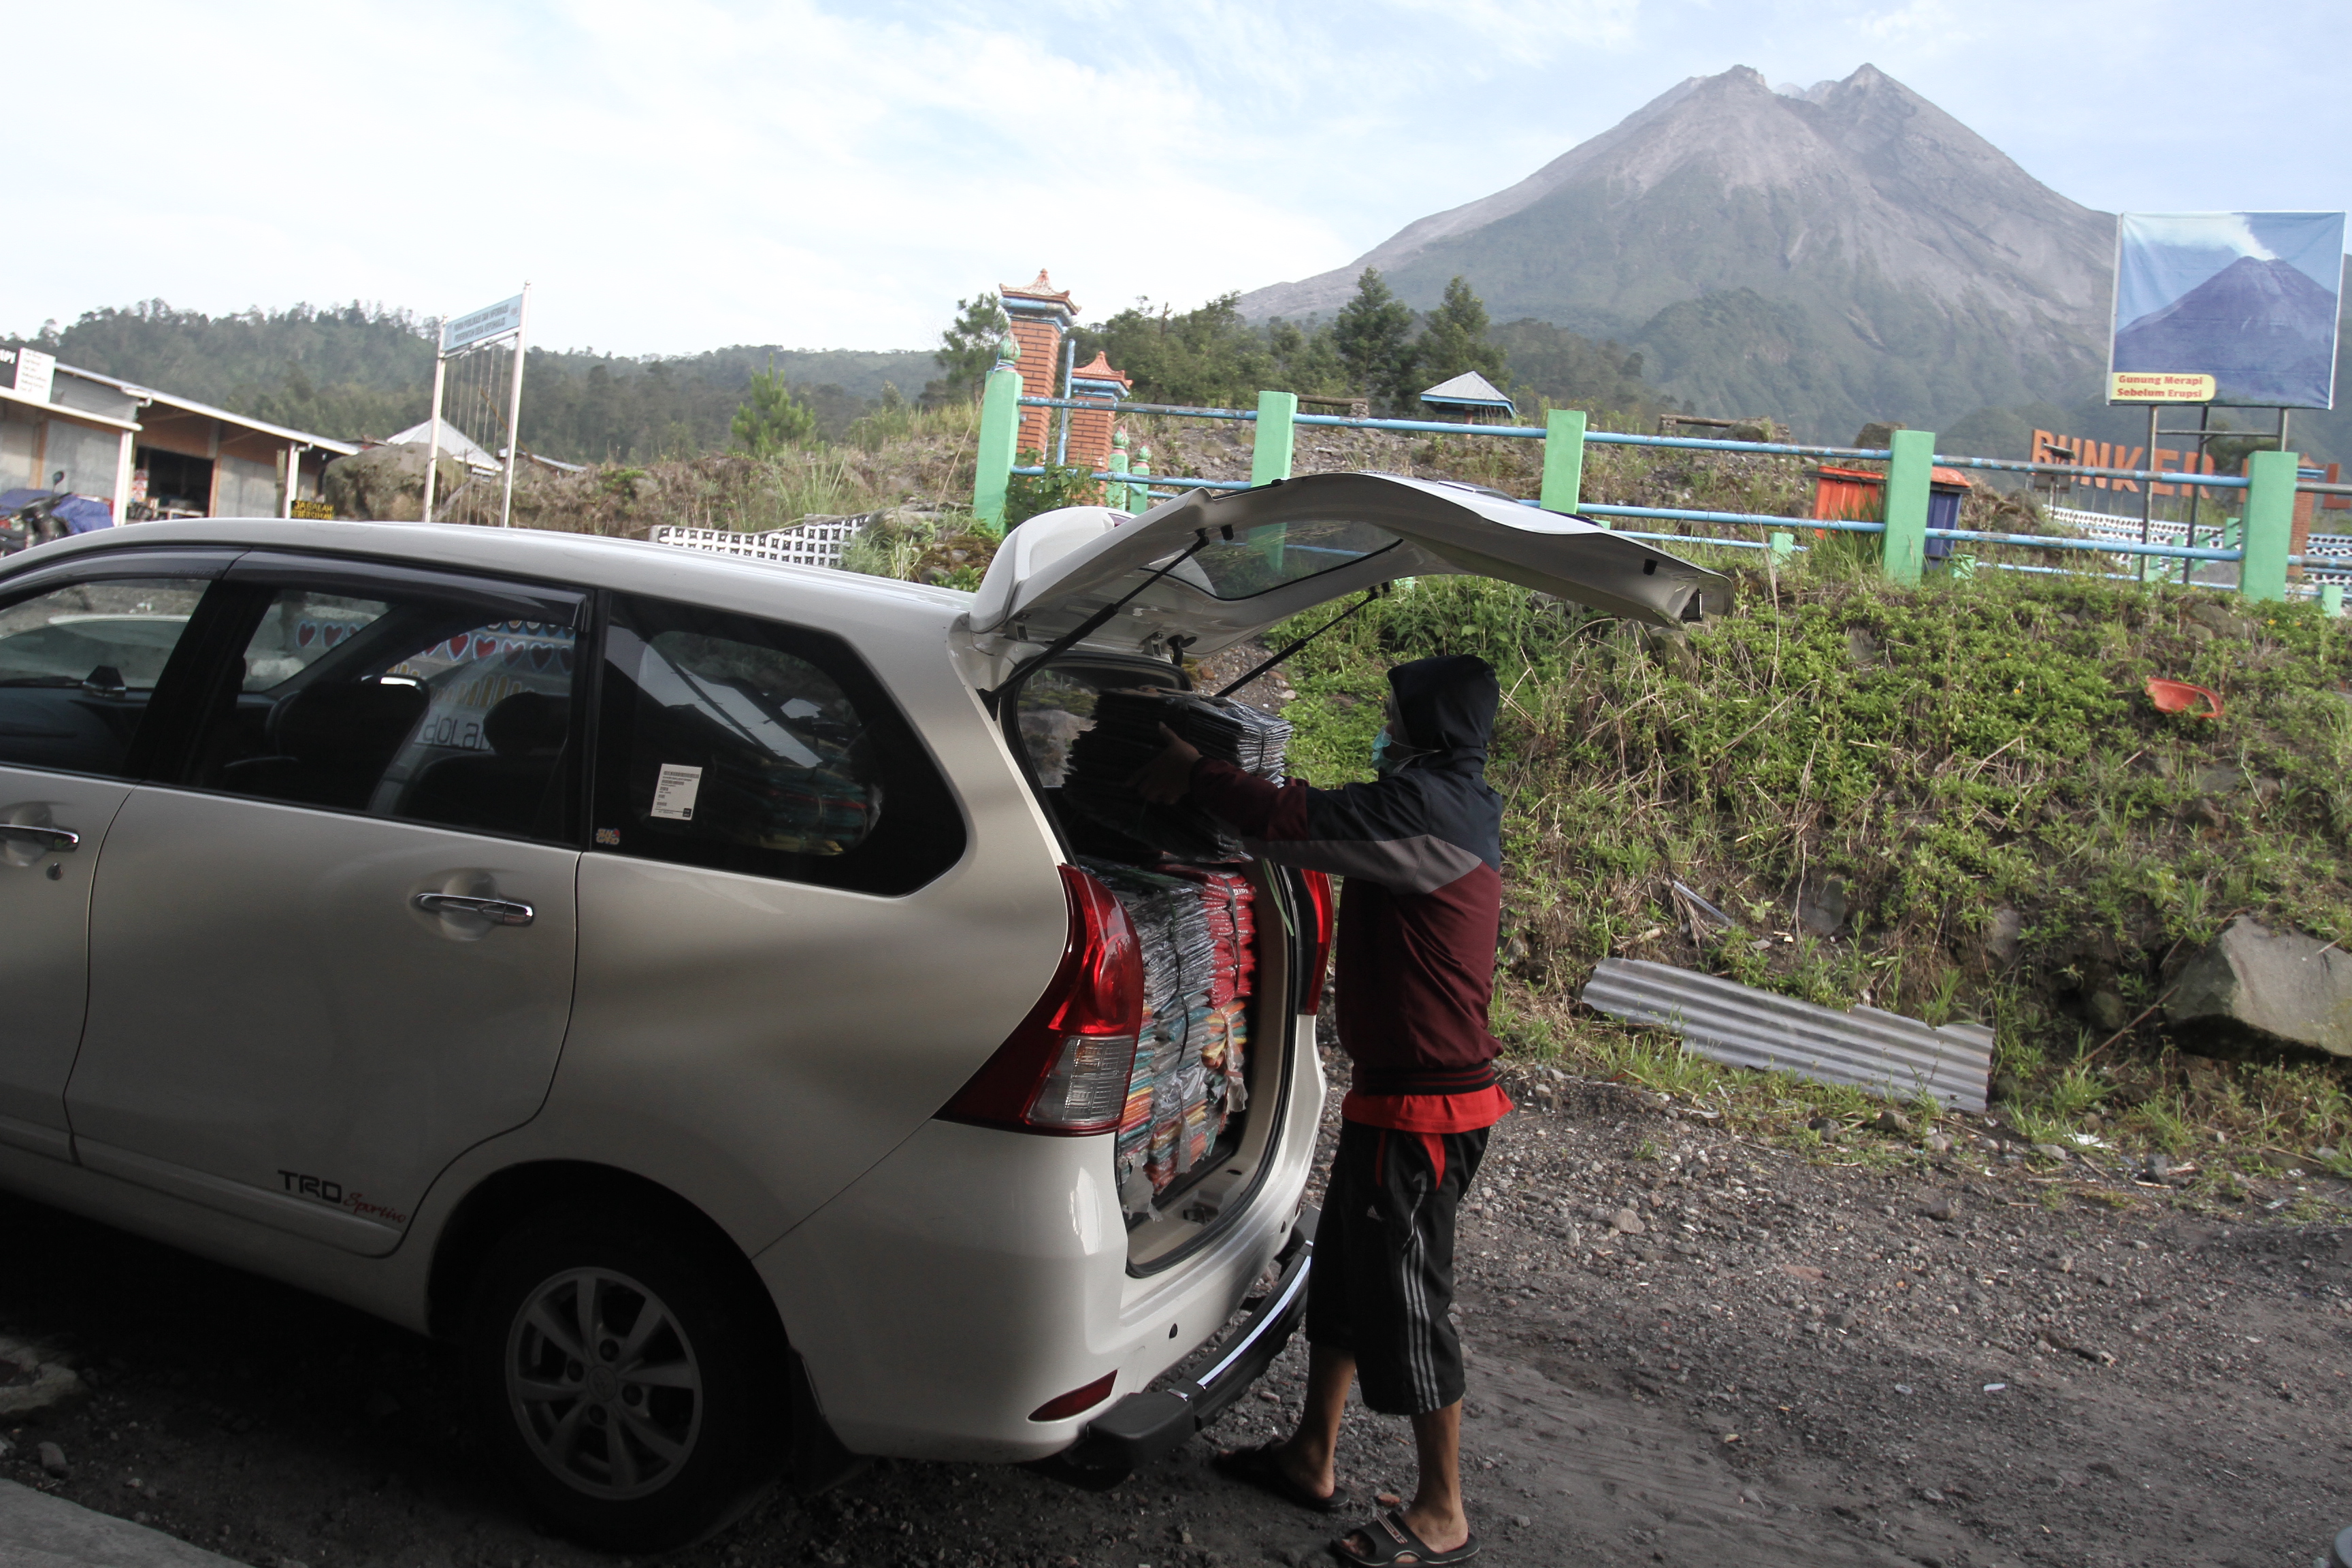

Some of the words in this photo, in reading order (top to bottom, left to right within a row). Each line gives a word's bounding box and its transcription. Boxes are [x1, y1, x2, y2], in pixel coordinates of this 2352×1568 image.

[2119, 375, 2161, 385] Gunung
[2164, 376, 2204, 386] Merapi
[2117, 388, 2165, 397] Sebelum
[2168, 389, 2202, 399] Erupsi
[294, 501, 333, 511] JAGALAH
[277, 1169, 342, 1204] TRD
[342, 1192, 407, 1224] Sportivo
